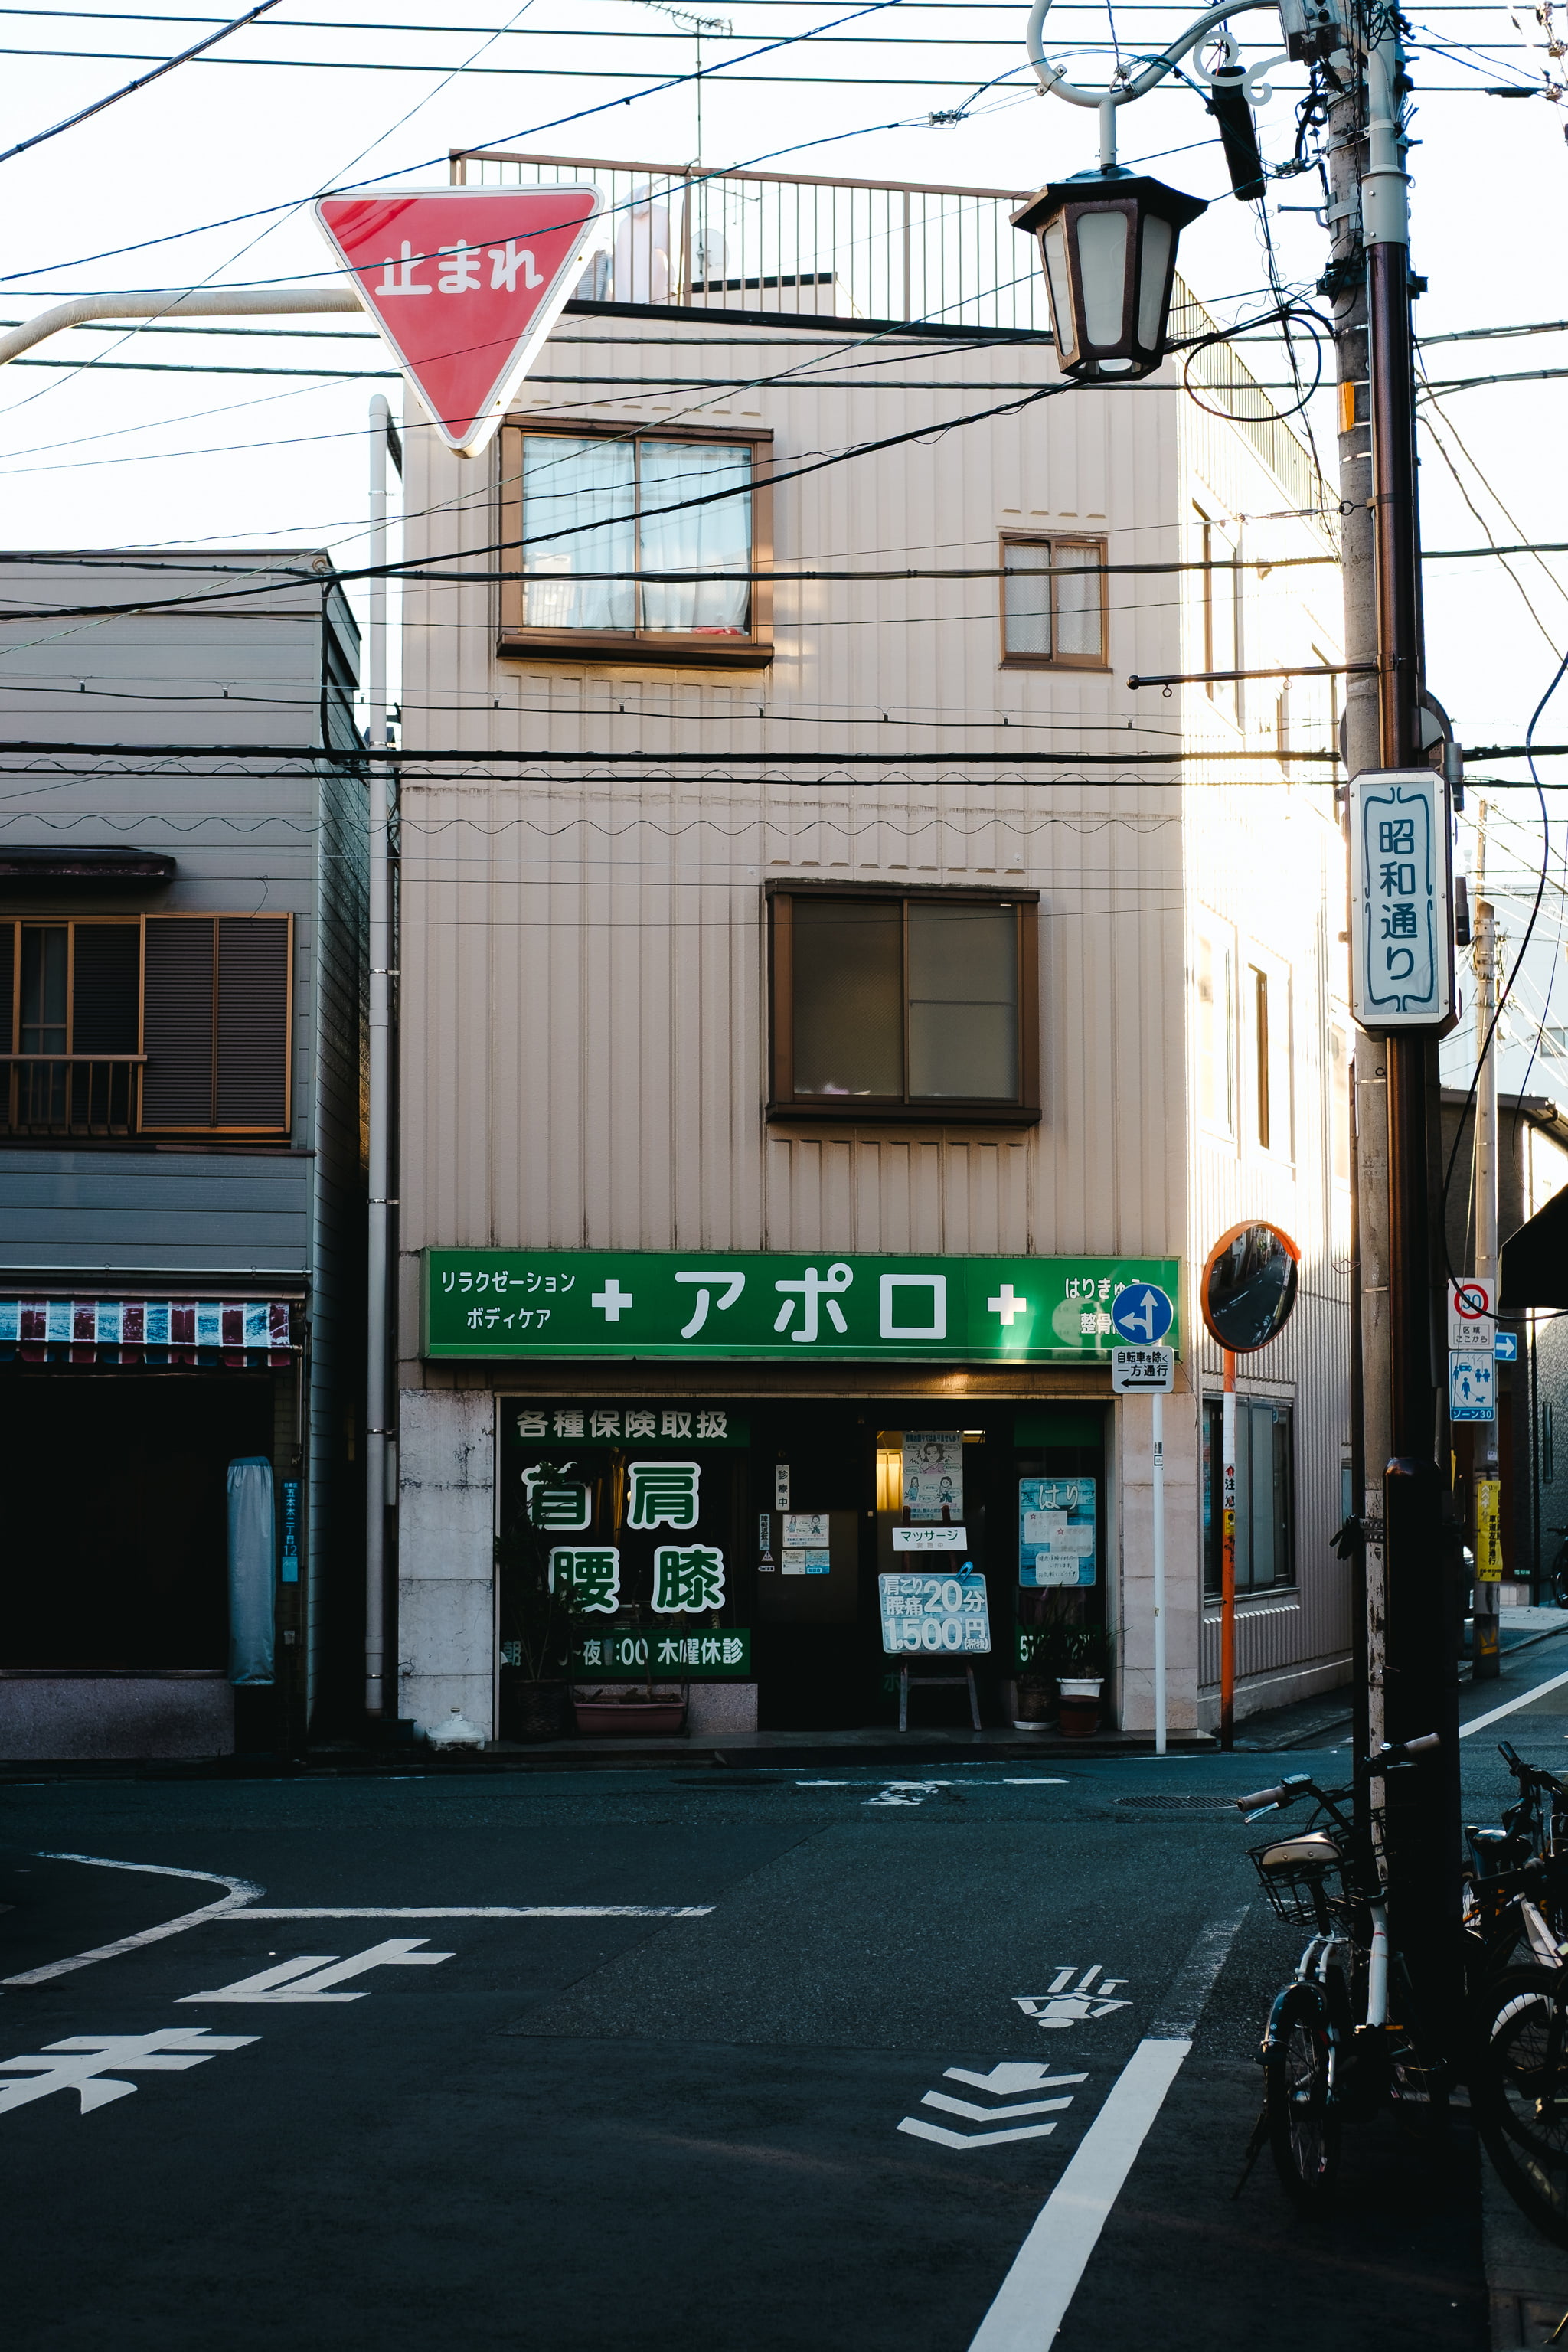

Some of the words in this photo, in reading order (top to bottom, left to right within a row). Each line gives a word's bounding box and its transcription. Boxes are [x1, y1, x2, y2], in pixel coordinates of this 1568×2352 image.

[375, 239, 544, 296] 止まれ
[1379, 818, 1418, 981] 昭和通り
[441, 1270, 576, 1293] リラクゼーション
[1065, 1278, 1140, 1300] はりきゅ
[674, 1262, 948, 1343] アポロ
[1462, 1294, 1482, 1310] 30
[466, 1306, 552, 1331] ボディケア
[1080, 1312, 1119, 1335] 整骨
[1455, 1335, 1488, 1344] ここから
[1117, 1351, 1168, 1364] 自転車を除く
[1117, 1364, 1168, 1377] 一方通行
[516, 1409, 728, 1439] 各種保険取扱
[626, 1461, 701, 1530] 肩
[777, 1469, 789, 1507] 診療中
[1039, 1484, 1079, 1510] はり
[900, 1530, 959, 1542] マッサージ
[283, 1545, 298, 1557] 12
[650, 1544, 726, 1614] 膝
[883, 1576, 923, 1596] 肩こり
[886, 1596, 924, 1615] 腰痛
[923, 1579, 985, 1613] 20分
[884, 1617, 986, 1651] 1,500円
[657, 1638, 745, 1667] 木曜休診
